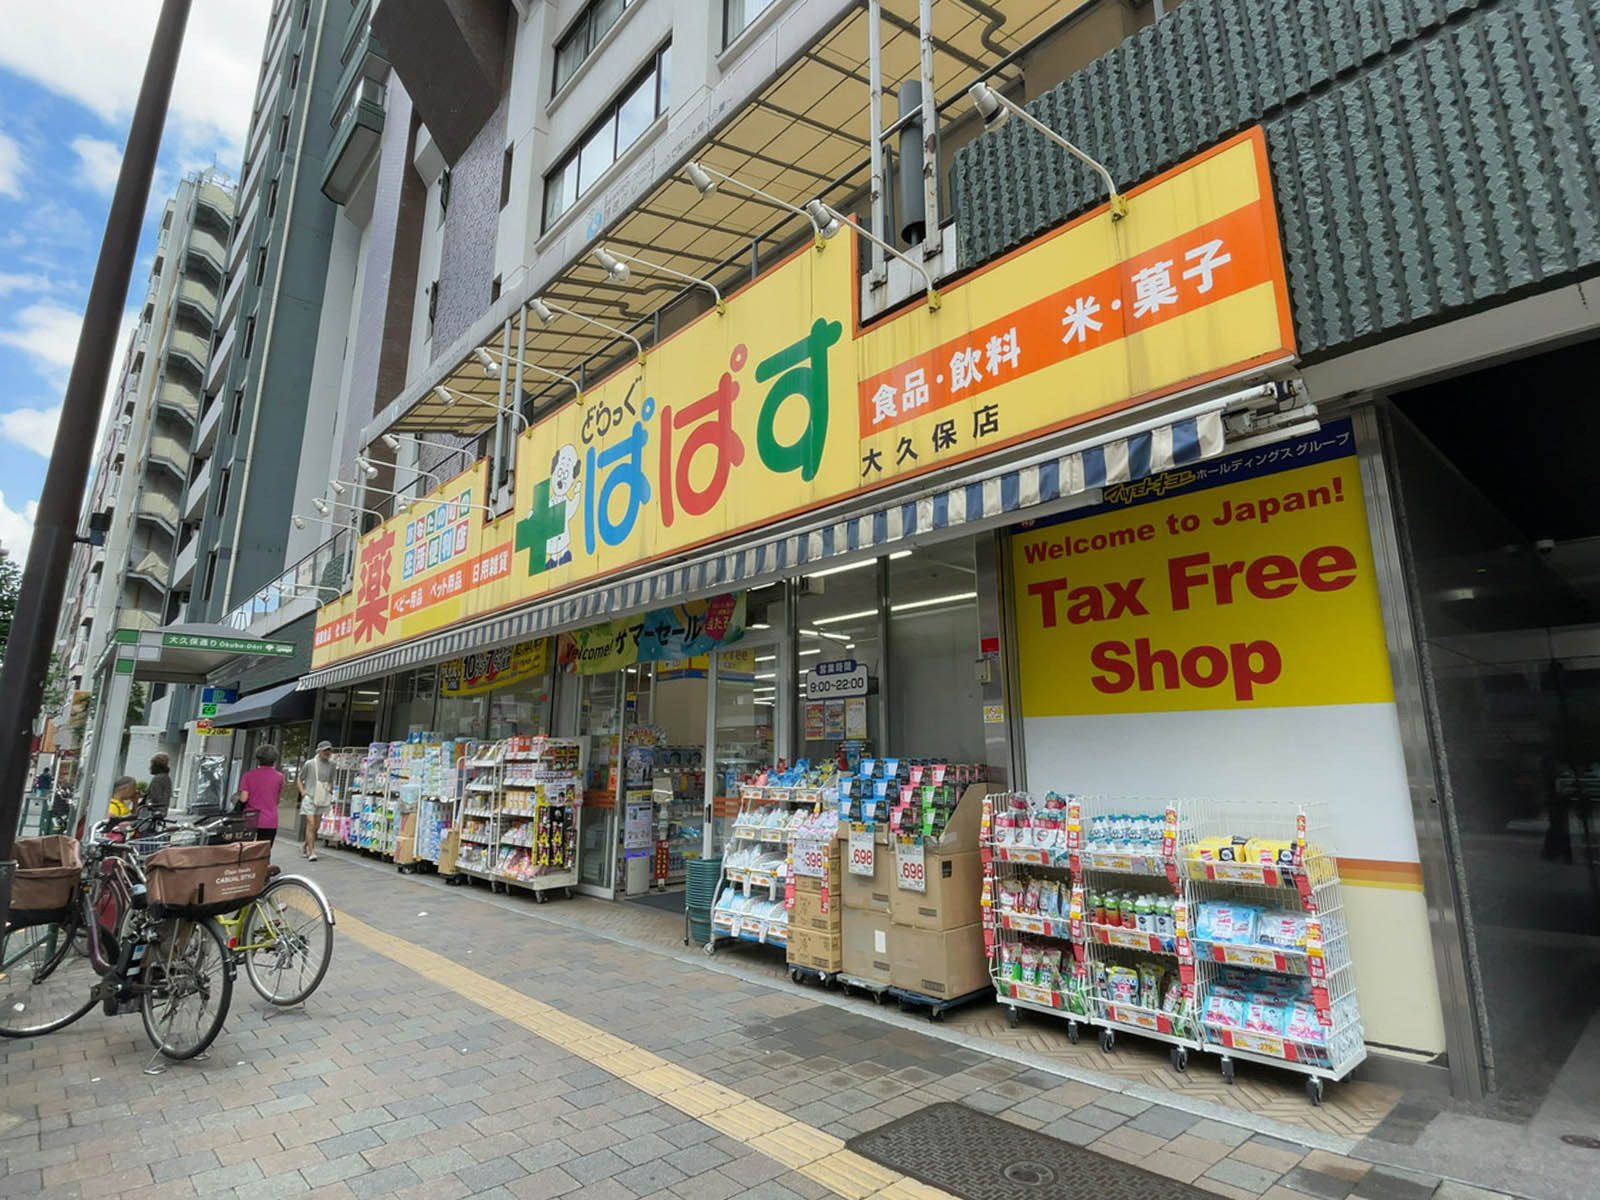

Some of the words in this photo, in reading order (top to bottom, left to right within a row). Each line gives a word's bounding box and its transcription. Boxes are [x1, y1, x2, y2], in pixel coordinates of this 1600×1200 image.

[872, 327, 1021, 425] 食品・飲料
[1061, 238, 1232, 345] 米・菓子
[581, 375, 642, 444] どらっぐ
[584, 317, 843, 556] ぱぱす
[861, 404, 1000, 478] 大久保店
[1294, 432, 1350, 461] グループ
[1024, 522, 1155, 564] Welcome
[1166, 513, 1201, 536] to
[1213, 476, 1345, 527] Japan!
[354, 532, 396, 644] 薬
[1028, 577, 1150, 629] Tax
[1168, 545, 1357, 611] Free
[169, 636, 217, 647] 大久保通り
[615, 615, 702, 654] サマーセール
[1090, 638, 1283, 701] Shop
[805, 851, 823, 868] 398
[854, 849, 873, 865] 698
[902, 862, 923, 880] 698
